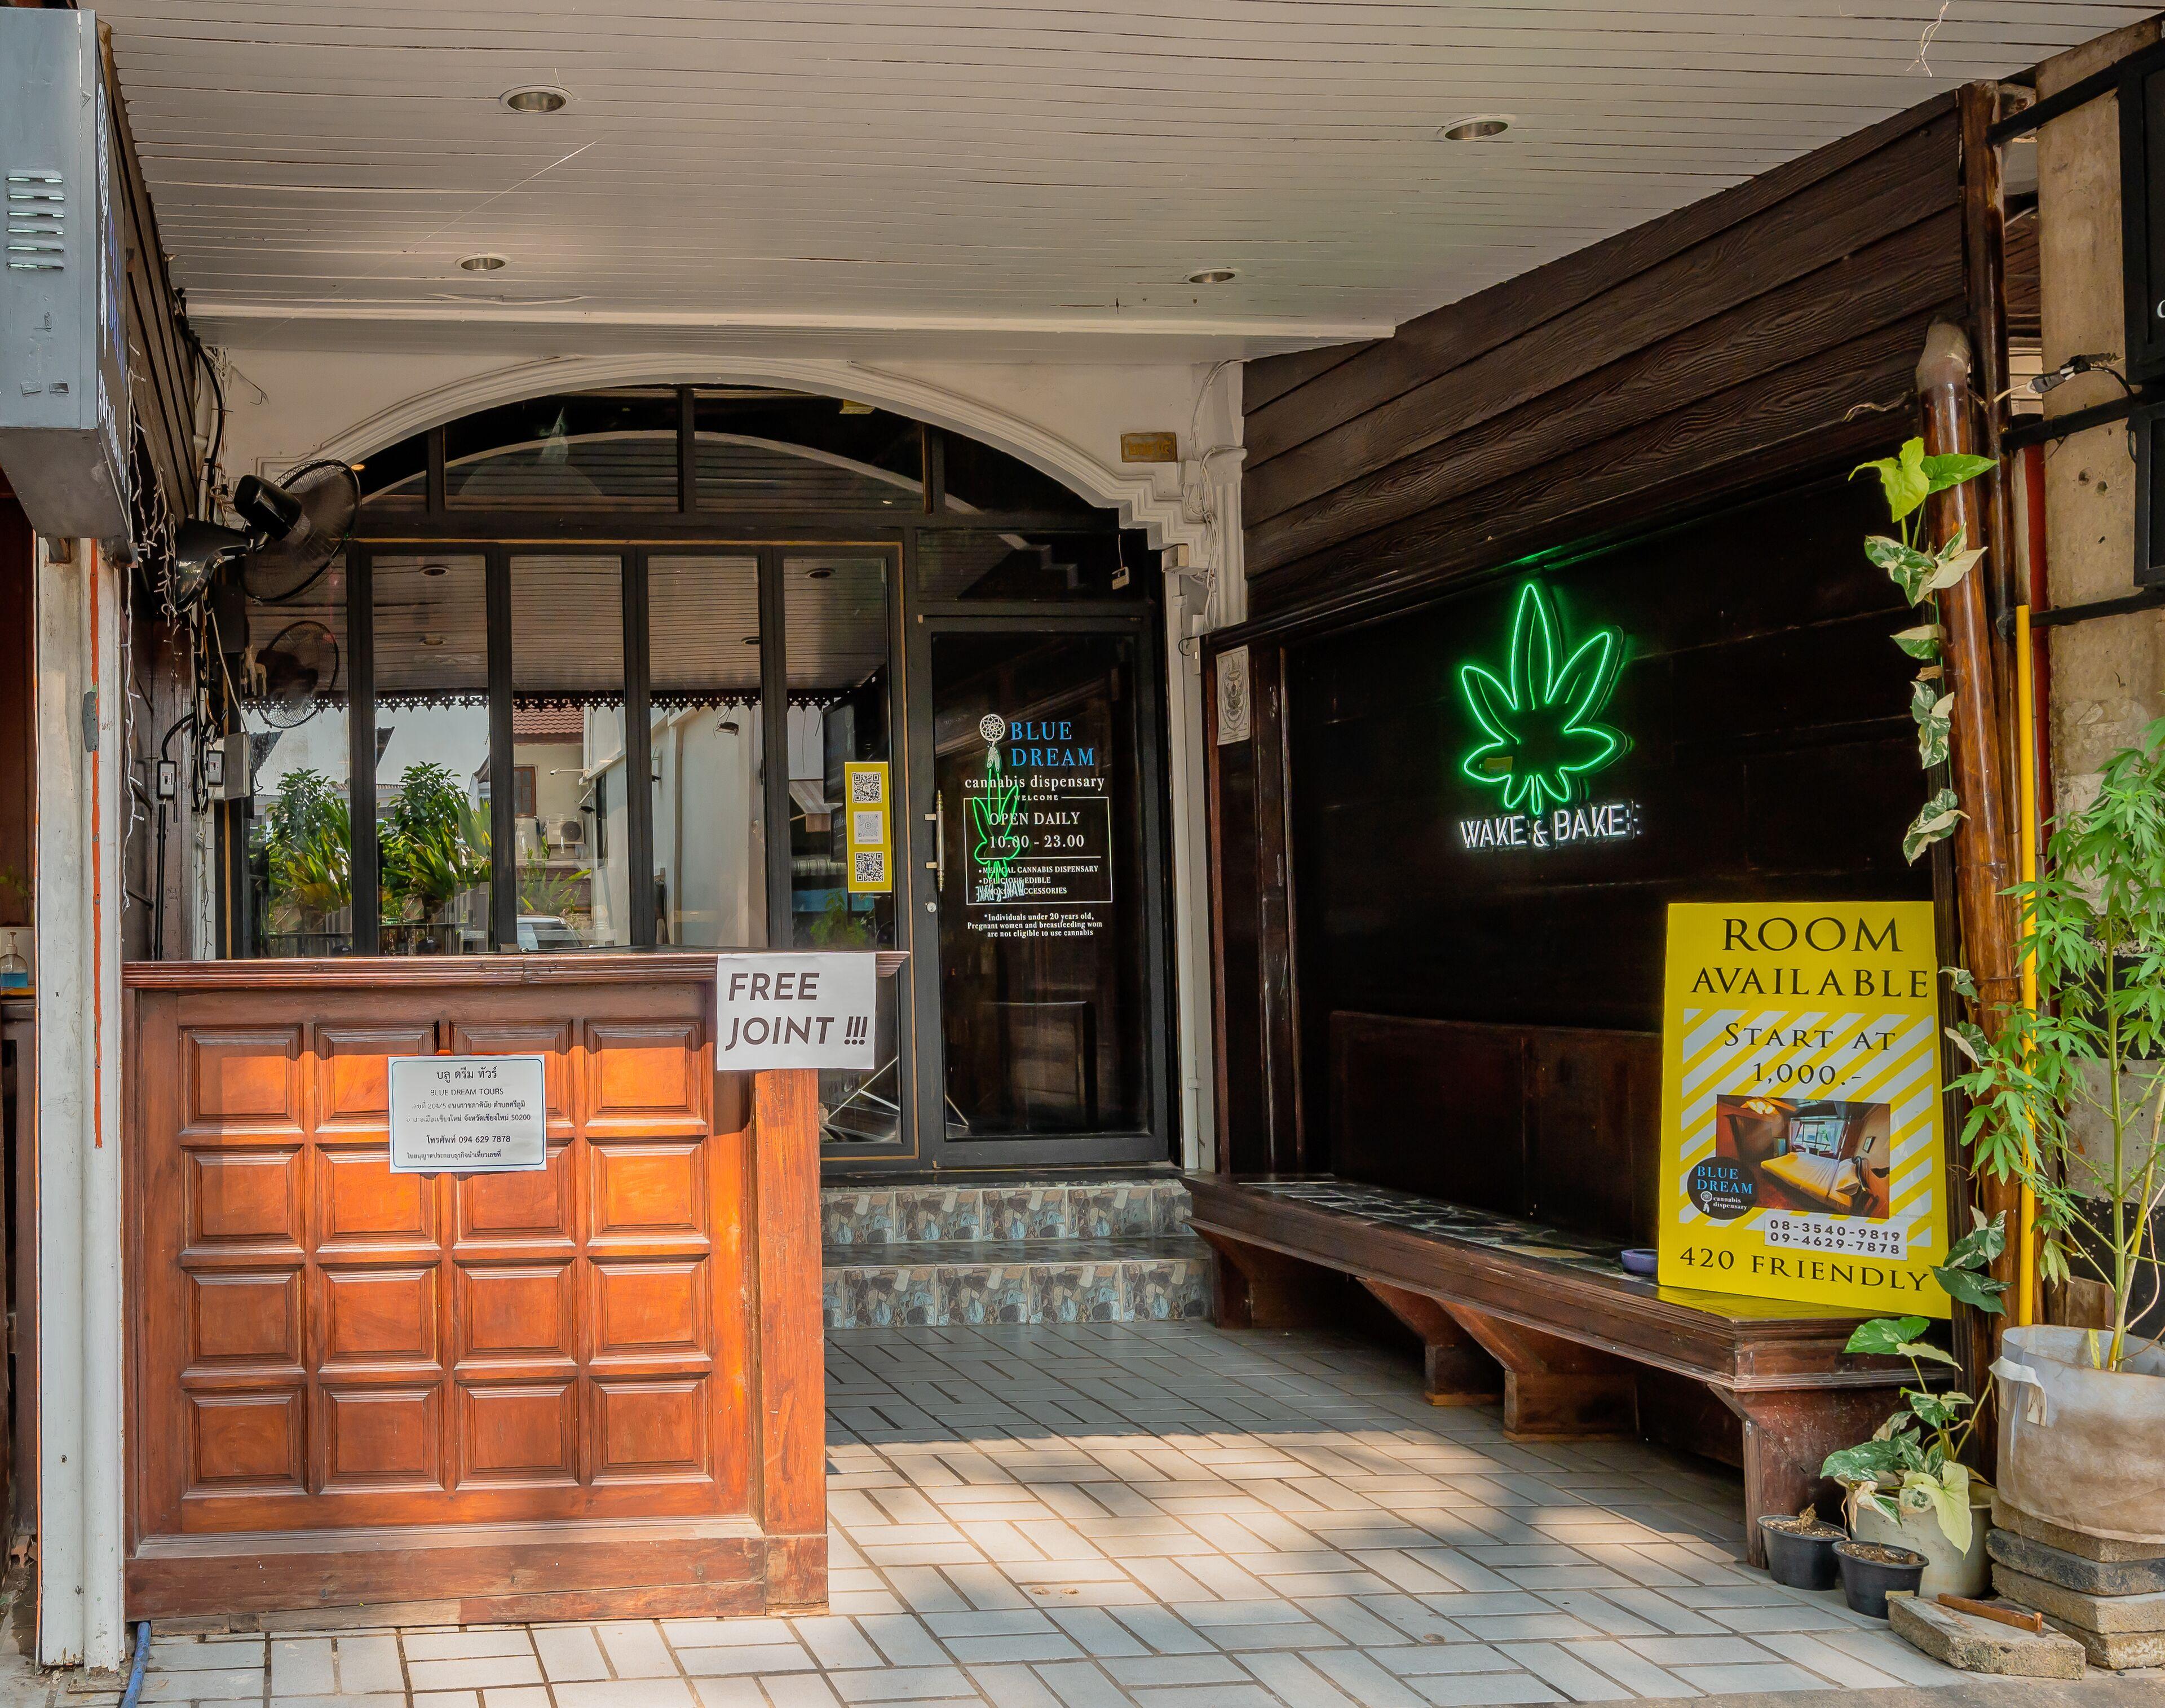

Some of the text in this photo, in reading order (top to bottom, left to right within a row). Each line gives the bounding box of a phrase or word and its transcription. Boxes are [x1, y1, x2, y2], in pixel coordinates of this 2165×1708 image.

[98, 369, 126, 494] guesthouse
[1010, 722, 1071, 740] BLUE
[1011, 748, 1094, 766] DREAM
[965, 775, 1104, 791] cannabis dispensary
[989, 812, 1080, 825] OPEN DAILY
[1459, 804, 1626, 848] WAKE & BAKE
[991, 835, 1029, 848] 10.00
[1044, 835, 1084, 848] 23.00
[1722, 917, 1903, 952] ROOM
[728, 972, 820, 1001] FREE
[1690, 967, 1928, 998] AVAILABLE
[725, 1016, 868, 1051] JOINT !!!
[1724, 1023, 1896, 1051] START AT
[437, 1066, 497, 1083] บลู ดรีม ทัวร์
[1753, 1063, 1862, 1086] 1,000.-
[426, 1134, 456, 1144] โทรศัพท์
[1697, 1166, 1738, 1179] BLUE
[1696, 1179, 1752, 1194] DREAM
[1713, 1202, 1747, 1210] dispensary
[1770, 1220, 1900, 1242] 08-3540-9819
[1771, 1233, 1900, 1255] 09-4629-7878
[1680, 1246, 1929, 1291] 420 FRIENDLY
